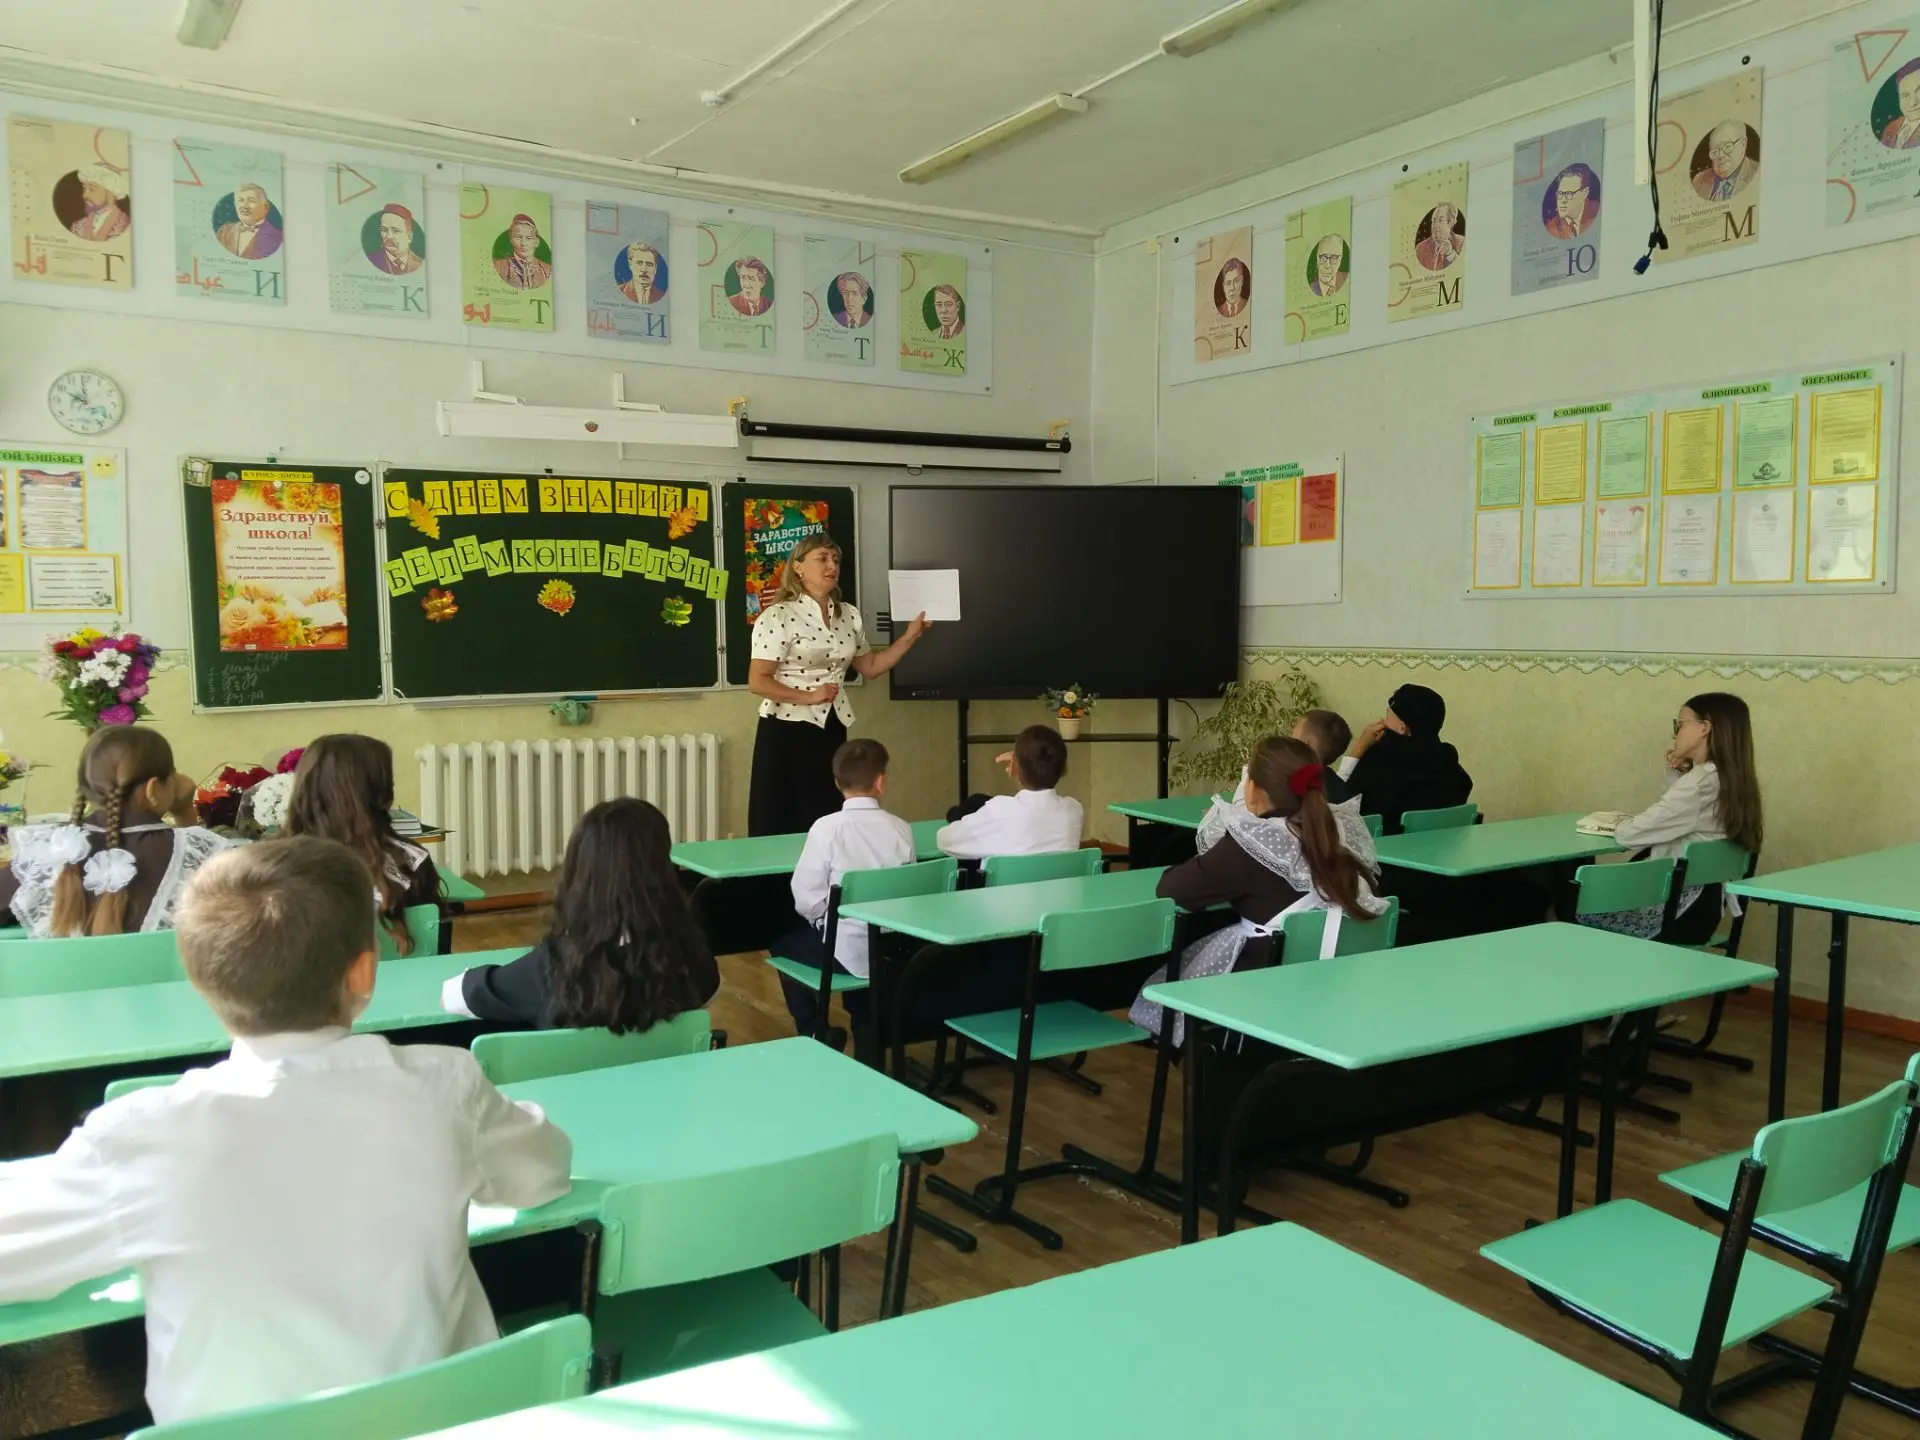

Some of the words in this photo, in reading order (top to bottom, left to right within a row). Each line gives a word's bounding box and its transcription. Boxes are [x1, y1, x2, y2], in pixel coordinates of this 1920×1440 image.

[1721, 203, 1757, 242] М
[101, 252, 126, 283] Г
[1565, 243, 1597, 277] Ю
[251, 269, 282, 299] И
[1435, 275, 1463, 307] М
[400, 285, 426, 313] К
[529, 298, 550, 325] Т
[643, 312, 668, 338] И
[1333, 303, 1347, 327] Е
[754, 324, 773, 349] Т
[854, 337, 871, 361] Т
[1234, 323, 1248, 350] К
[1494, 414, 1535, 426] ГОТОВИМСЯ
[0, 451, 84, 465] ӨЙЛӘШӘБЕЗ
[387, 489, 408, 510] С
[429, 482, 529, 513] ДНЁМ
[220, 508, 333, 526] Здравствуй,
[247, 526, 312, 541] школа!
